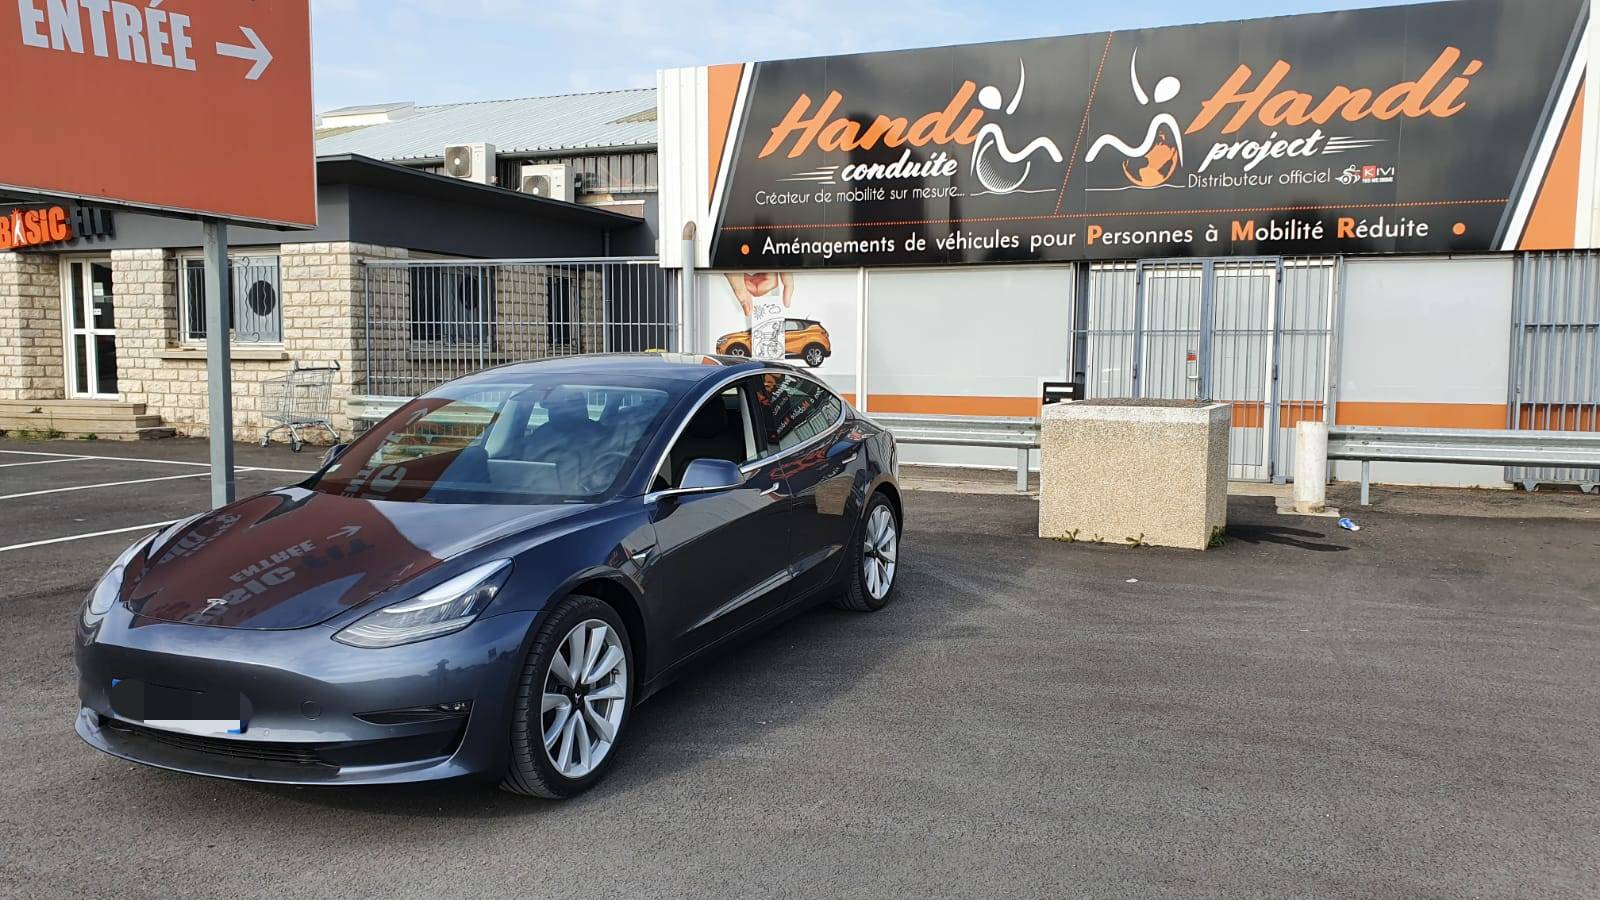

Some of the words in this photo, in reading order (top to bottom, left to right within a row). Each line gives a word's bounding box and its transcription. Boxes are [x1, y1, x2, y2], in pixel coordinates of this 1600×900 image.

[18, 0, 197, 71] ENTRÉE
[1184, 46, 1483, 135] Handi
[757, 79, 985, 159] Handi
[841, 148, 958, 182] conduite
[1198, 129, 1325, 173] project
[1362, 166, 1395, 177] KIVI
[755, 190, 810, 205] Créateur
[814, 188, 832, 203] de
[836, 186, 885, 202] mobilité
[890, 187, 909, 200] sur
[912, 185, 965, 199] mesure...
[1188, 171, 1273, 188] Distributeur
[1279, 168, 1331, 185] officiel
[762, 236, 895, 259] Aménagements
[904, 232, 926, 251] de
[936, 229, 1020, 250] véhicules
[1030, 232, 1076, 253] pour
[1087, 225, 1193, 245] Personnes
[1205, 223, 1218, 242] à
[1231, 219, 1324, 242] Mobilité
[1337, 216, 1428, 239] Réduite
